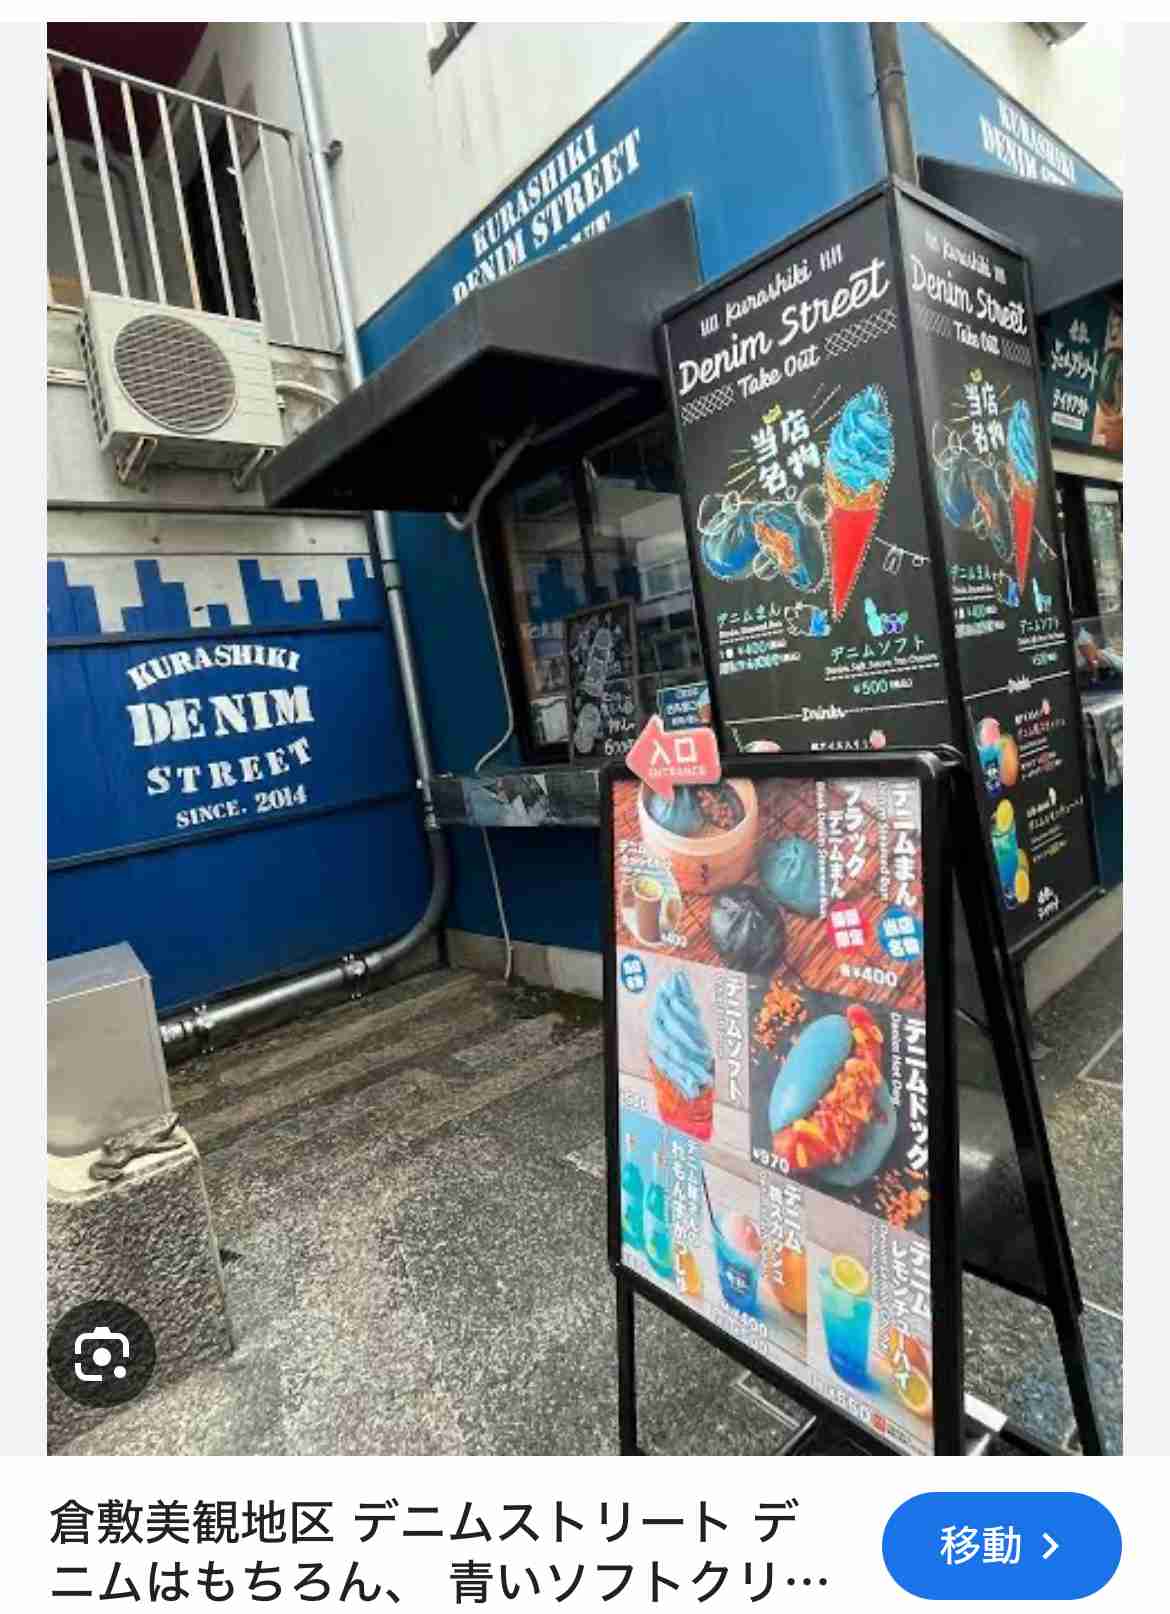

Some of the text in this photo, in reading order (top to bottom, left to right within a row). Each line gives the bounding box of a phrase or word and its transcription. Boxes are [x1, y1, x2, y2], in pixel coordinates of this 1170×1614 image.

[472, 125, 597, 257] KURASHIKI
[531, 128, 640, 249] STREET
[679, 257, 890, 396] Denim Street
[910, 255, 974, 314] Denim
[976, 287, 1028, 336] Street
[737, 345, 820, 399] Take Out
[750, 409, 809, 463] 当店
[759, 442, 820, 495] 名物
[127, 644, 300, 691] KURASHIKI
[831, 635, 925, 663] デニムソフト
[126, 685, 314, 747] DENIM
[650, 737, 698, 766] 入口
[147, 736, 312, 795] STREET
[176, 784, 307, 829] SINCE. 2014
[845, 784, 866, 879] ブラック
[828, 810, 846, 900] デニムまん
[892, 782, 917, 907] デニムまん
[724, 976, 743, 1101] デニムソフト
[783, 1181, 801, 1254] デニム
[911, 1240, 931, 1320] デニム
